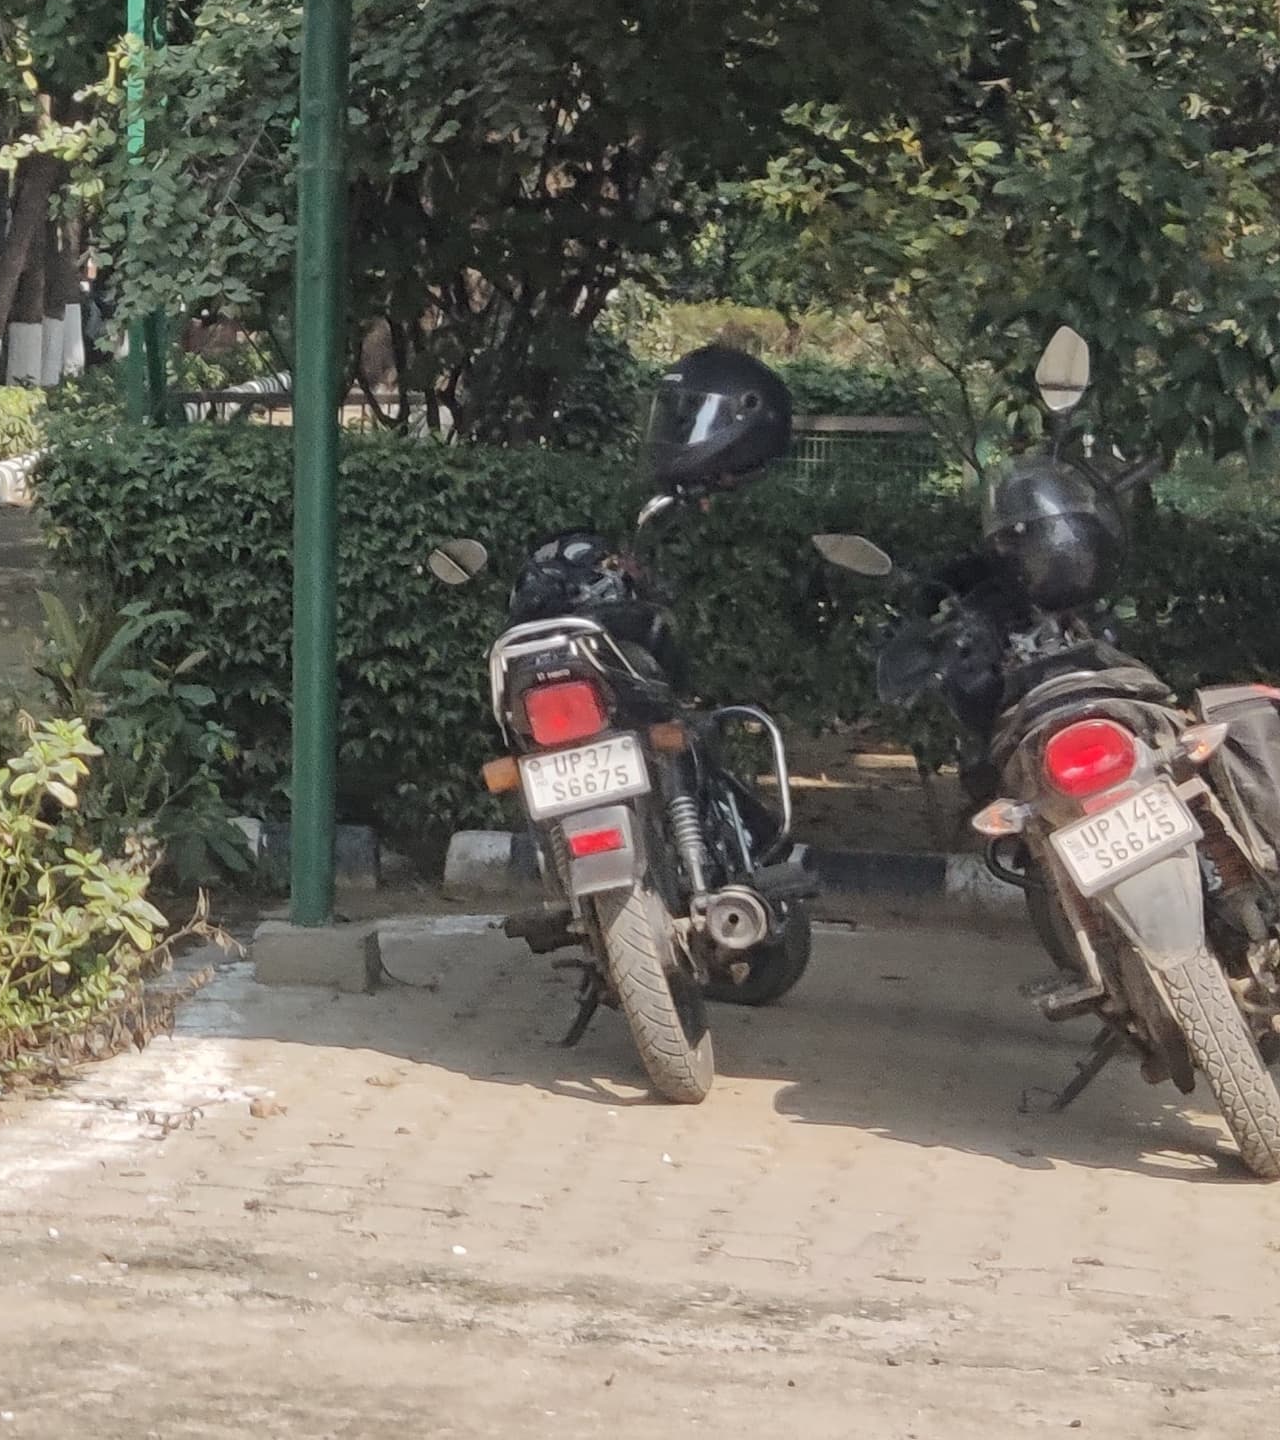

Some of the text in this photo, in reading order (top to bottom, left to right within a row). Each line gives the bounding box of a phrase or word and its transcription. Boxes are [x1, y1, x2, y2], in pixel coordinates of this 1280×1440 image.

[552, 744, 613, 776] UP37
[552, 764, 629, 802] S6675
[1095, 814, 1176, 869] S6645
